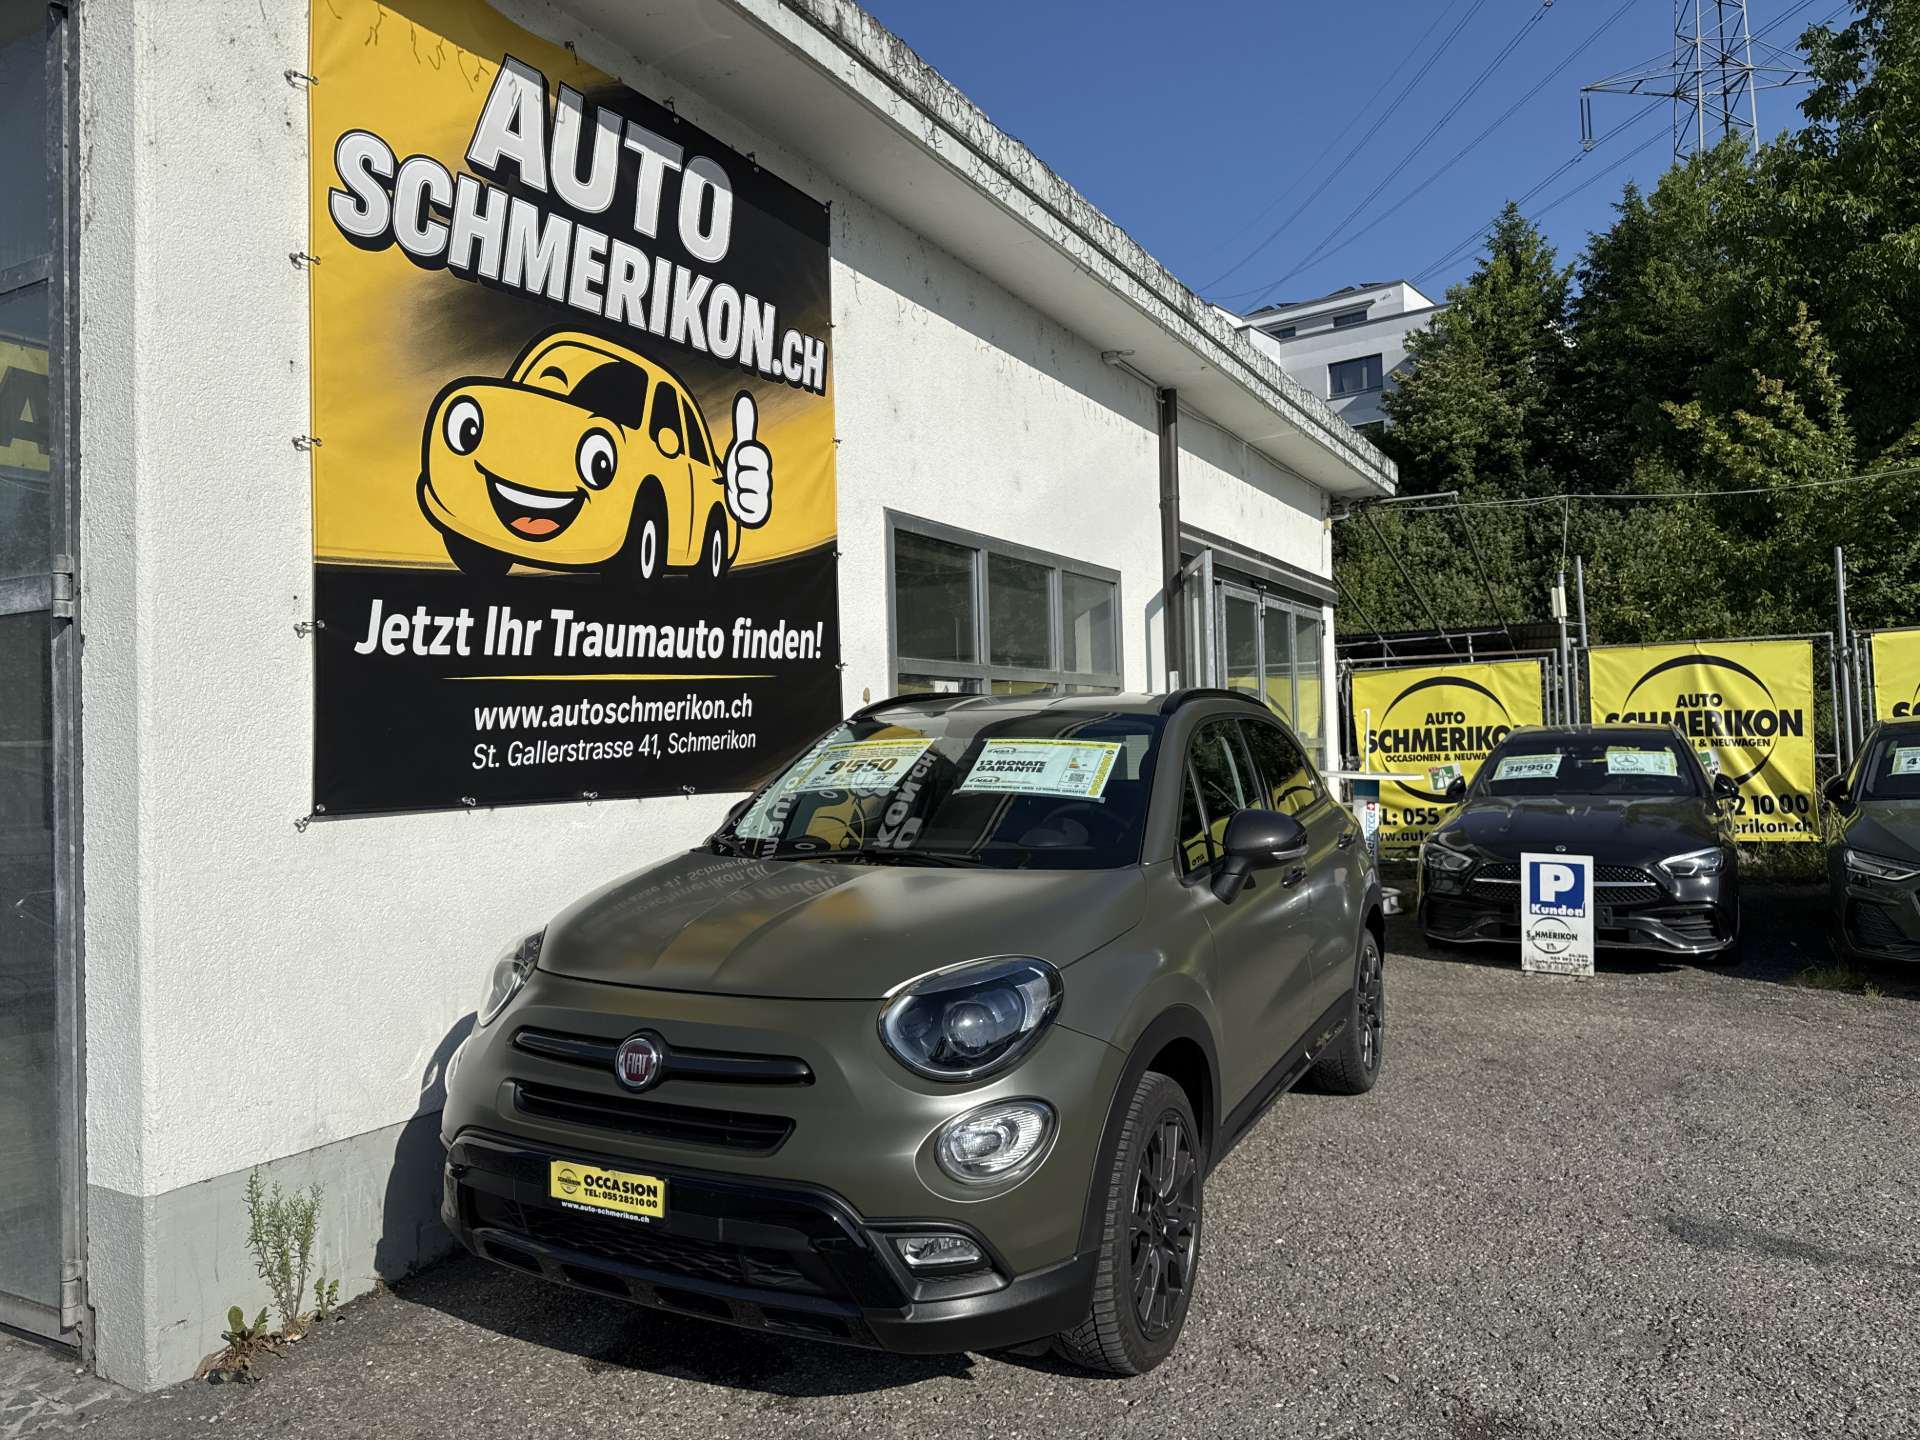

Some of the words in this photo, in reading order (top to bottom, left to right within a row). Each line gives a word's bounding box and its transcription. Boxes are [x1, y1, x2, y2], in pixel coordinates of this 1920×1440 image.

[466, 54, 734, 263] AUTO
[330, 132, 826, 391] SCHMERIKON.CH
[354, 598, 475, 656] Jetzt
[483, 605, 542, 657] Ihr
[550, 608, 726, 660] Traumauto
[732, 616, 824, 660] finden!
[473, 692, 753, 732] www.autoschmerikon.ch
[1676, 693, 1723, 709] AUTO
[1424, 711, 1466, 726] AUTO
[471, 743, 500, 770] St.
[507, 735, 634, 768] Gallerstrasse
[638, 734, 662, 761] 41,
[667, 729, 757, 756] Schmerikon
[1364, 724, 1512, 754] SCHMERIKO
[1711, 737, 1771, 748] NEUWAGEN
[994, 759, 1047, 768] MONATE
[1385, 754, 1441, 763] OCCASIONEN
[976, 766, 1045, 774] GARANTIE
[1403, 807, 1440, 826] 055
[1540, 863, 1575, 902] P
[1531, 903, 1584, 917] Kunden
[626, 1051, 649, 1075] FIAT
[583, 1174, 658, 1198] OCCASION
[584, 1188, 601, 1198] TEL:
[561, 1201, 650, 1223] www.auto-schmerikon.ch
